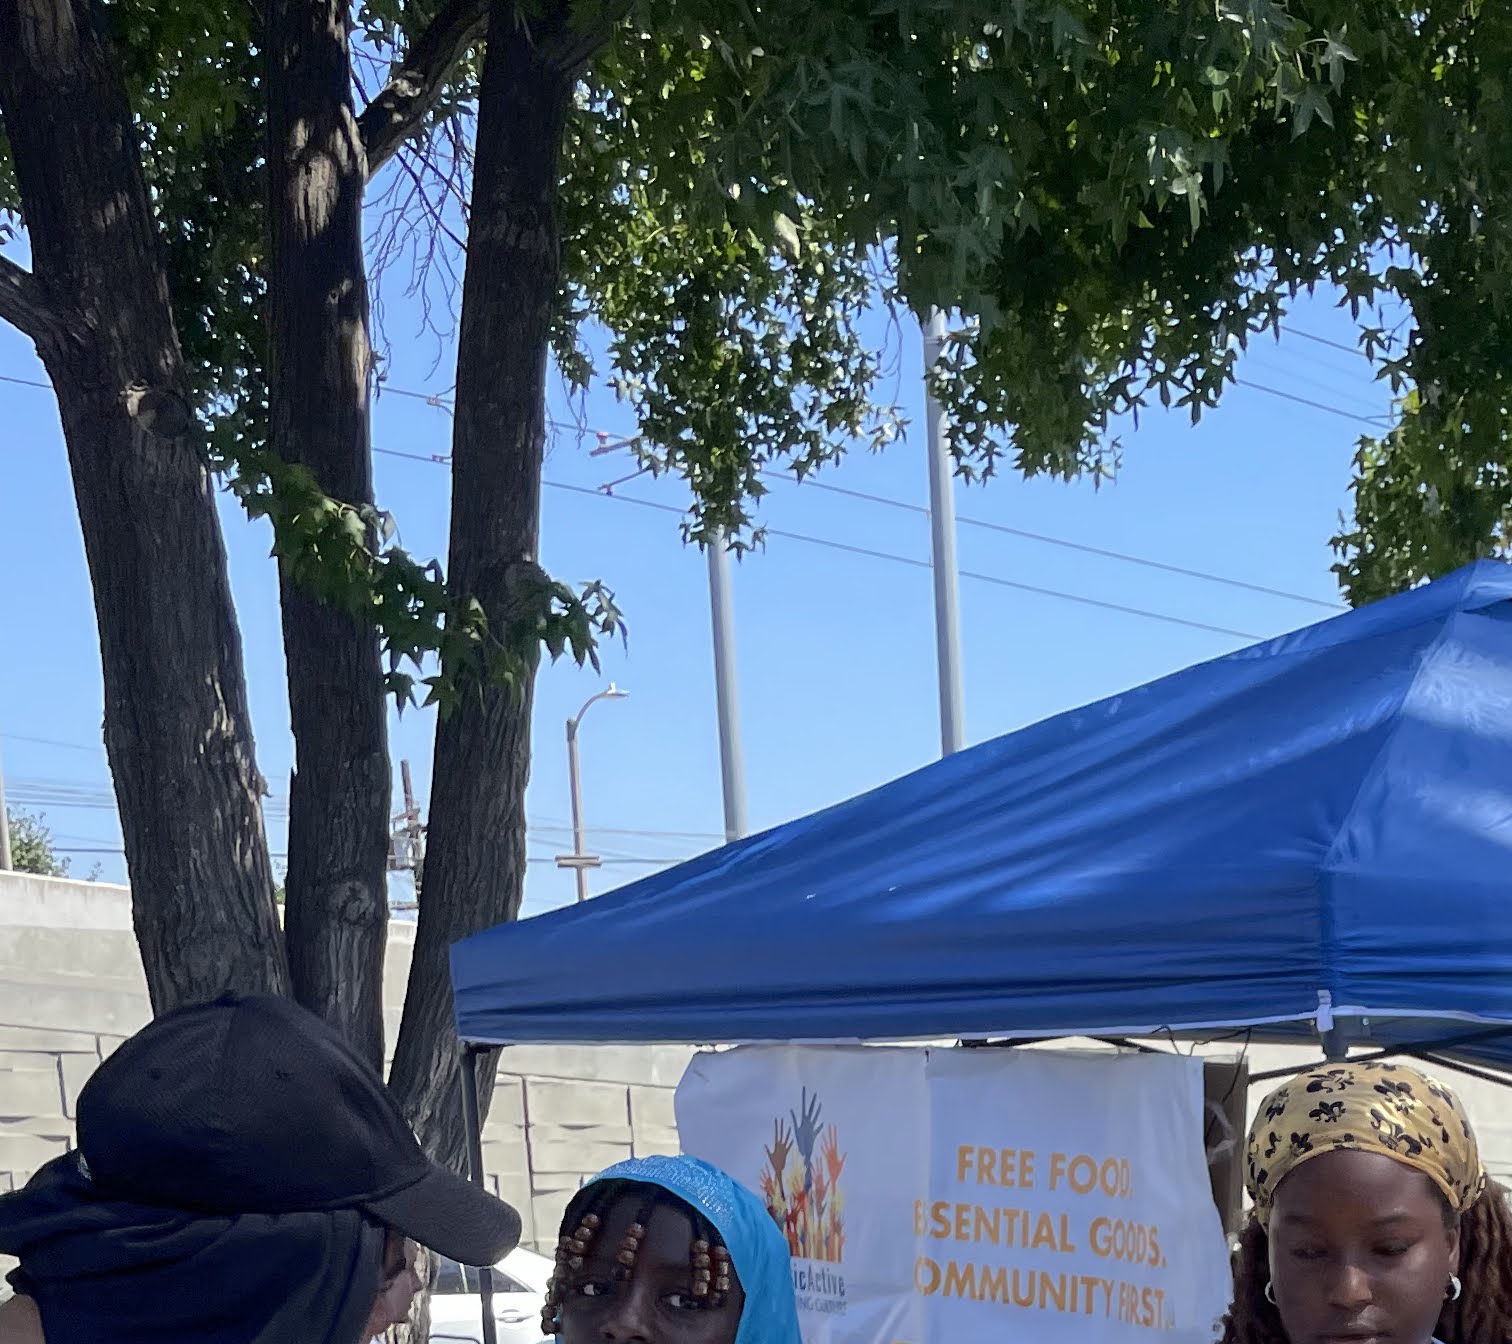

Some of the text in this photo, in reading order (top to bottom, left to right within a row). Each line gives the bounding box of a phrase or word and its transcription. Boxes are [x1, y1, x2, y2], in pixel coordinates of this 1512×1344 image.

[957, 1145, 1035, 1188] FREE
[914, 1199, 1168, 1268] ESENTIAL GOODS.
[794, 1263, 845, 1296] icActive
